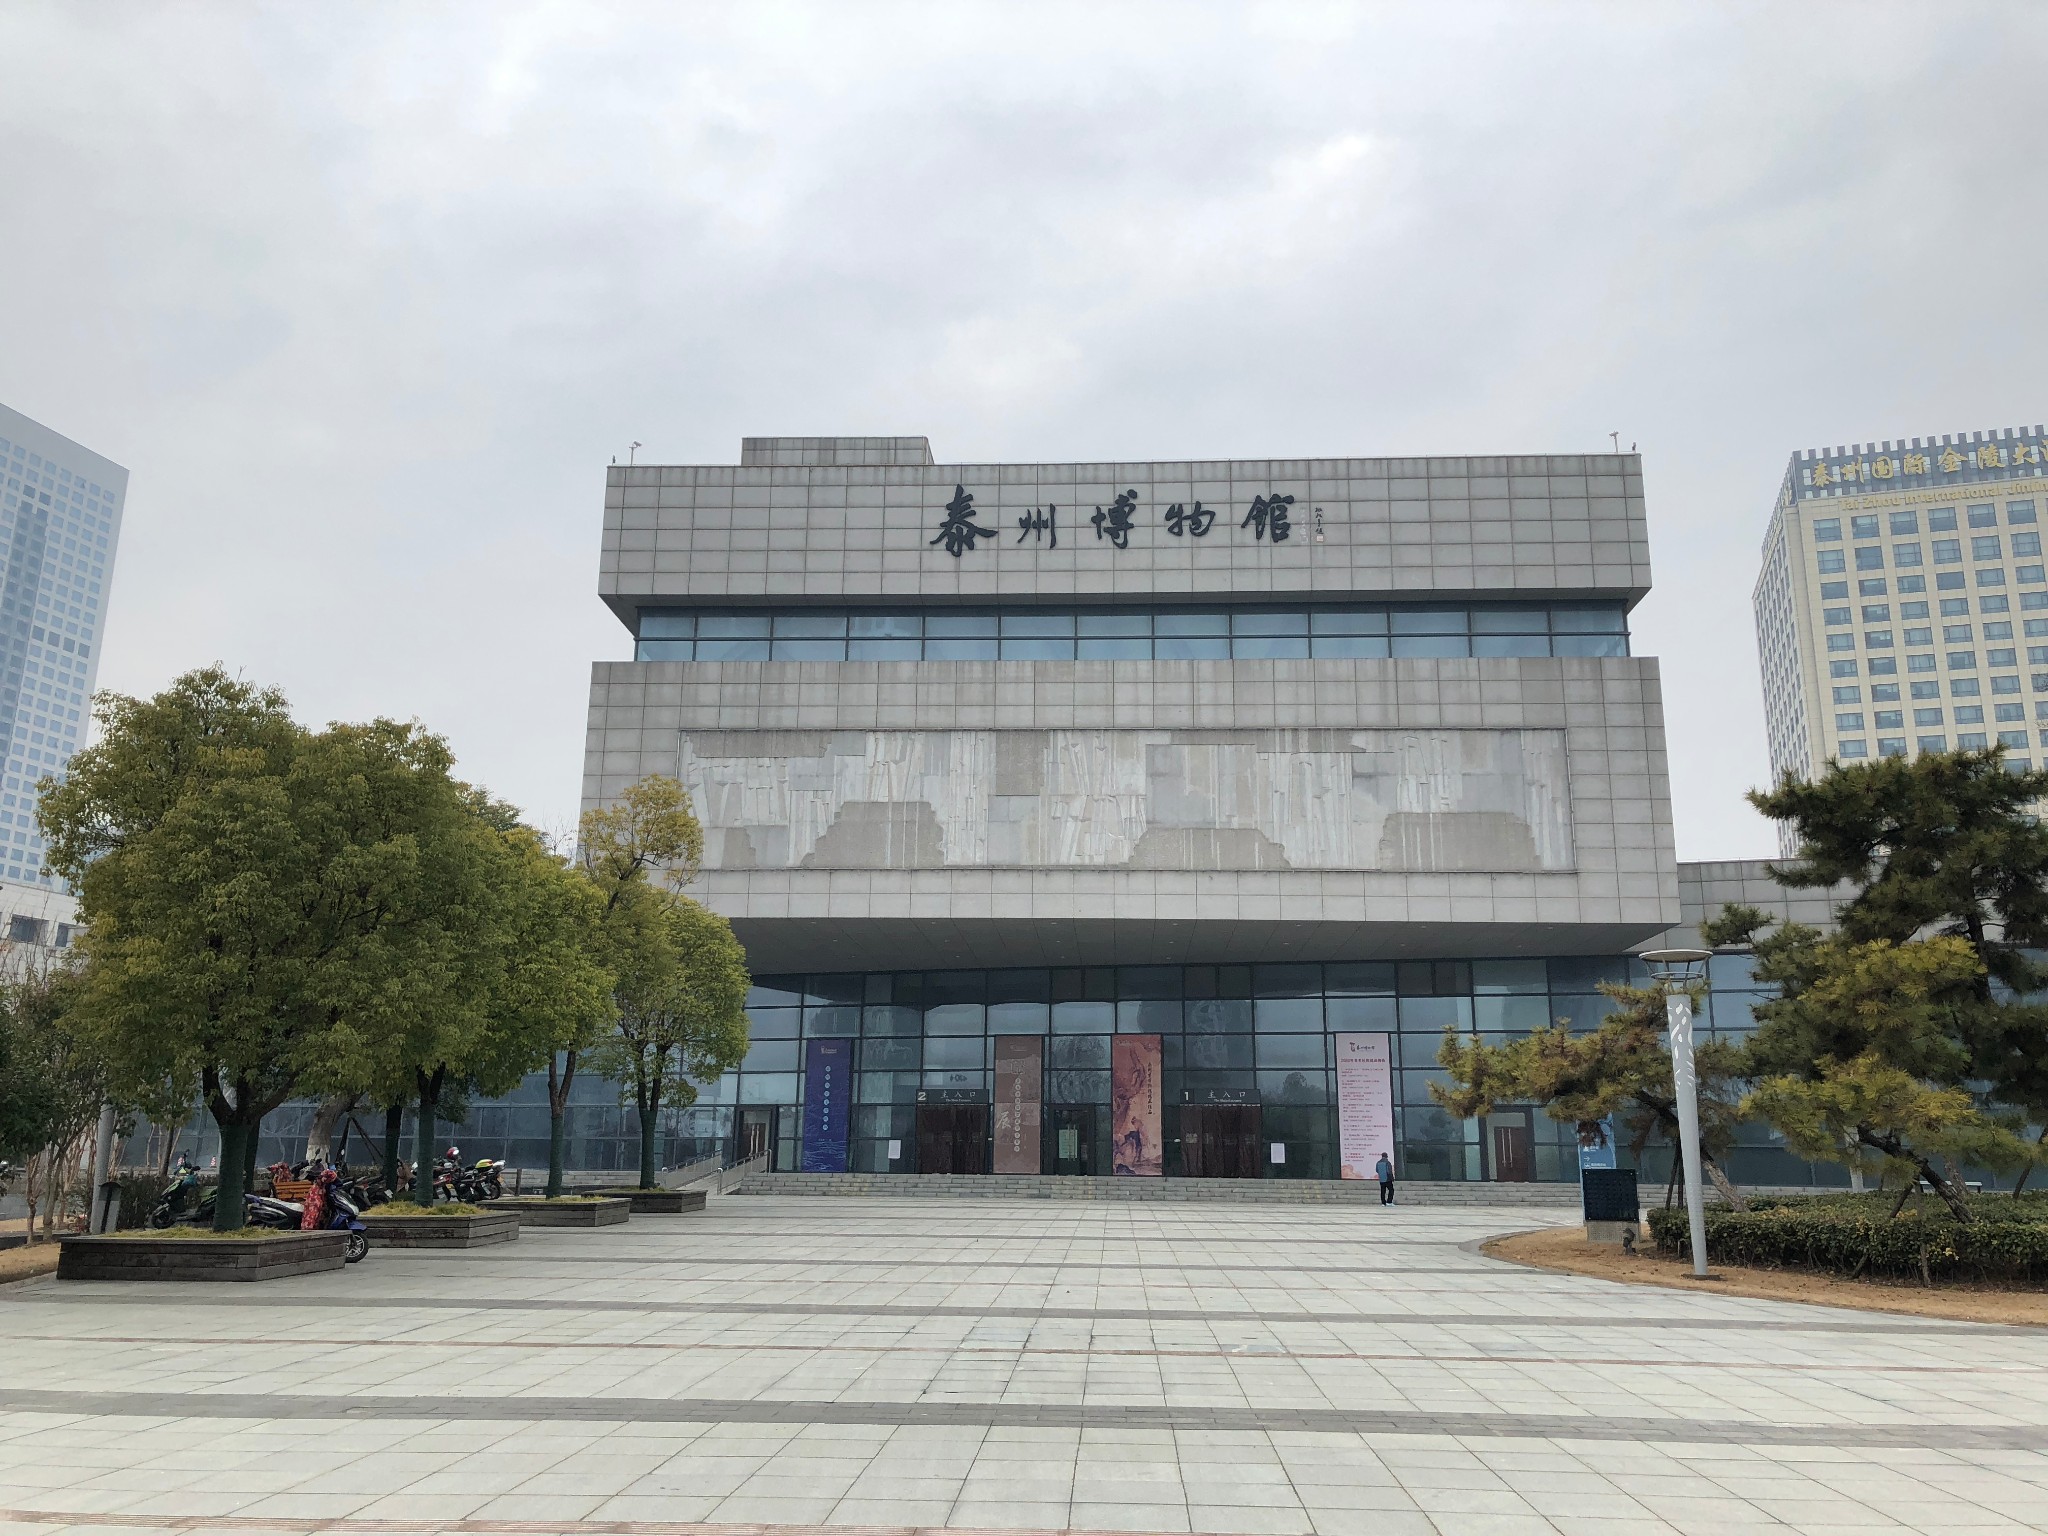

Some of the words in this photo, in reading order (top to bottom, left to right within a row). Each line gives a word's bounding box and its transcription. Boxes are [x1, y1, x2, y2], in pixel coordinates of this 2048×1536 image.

[917, 1091, 927, 1101] 2
[940, 1089, 976, 1099] 主入口
[1184, 1091, 1189, 1101] 1
[1207, 1089, 1246, 1099] 主入口
